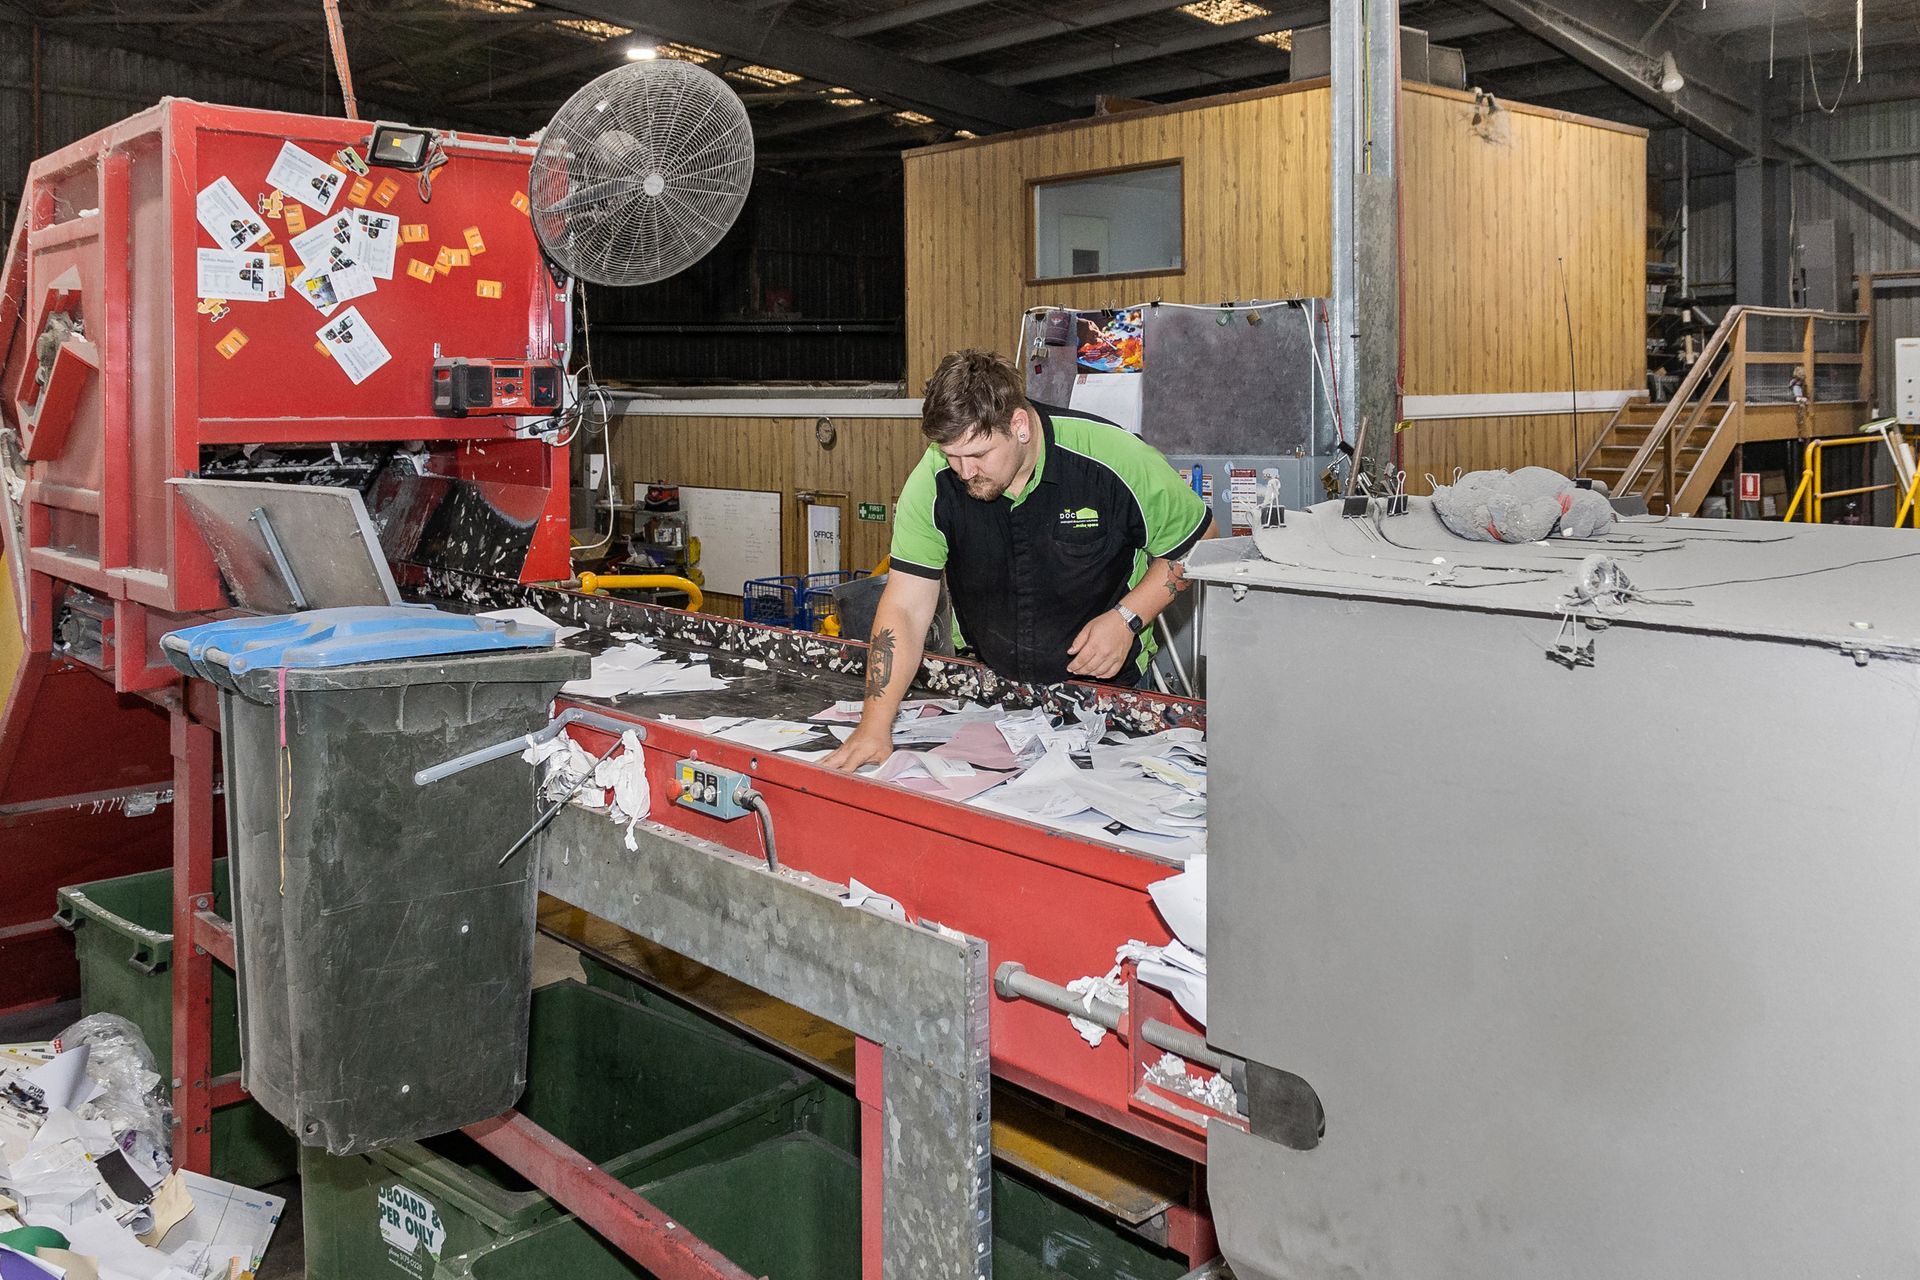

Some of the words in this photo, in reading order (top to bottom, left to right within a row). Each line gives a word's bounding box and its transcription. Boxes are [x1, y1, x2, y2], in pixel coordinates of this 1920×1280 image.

[813, 530, 834, 539] OFFICE
[431, 1209, 441, 1231] &
[405, 1216, 434, 1247] ONLY
